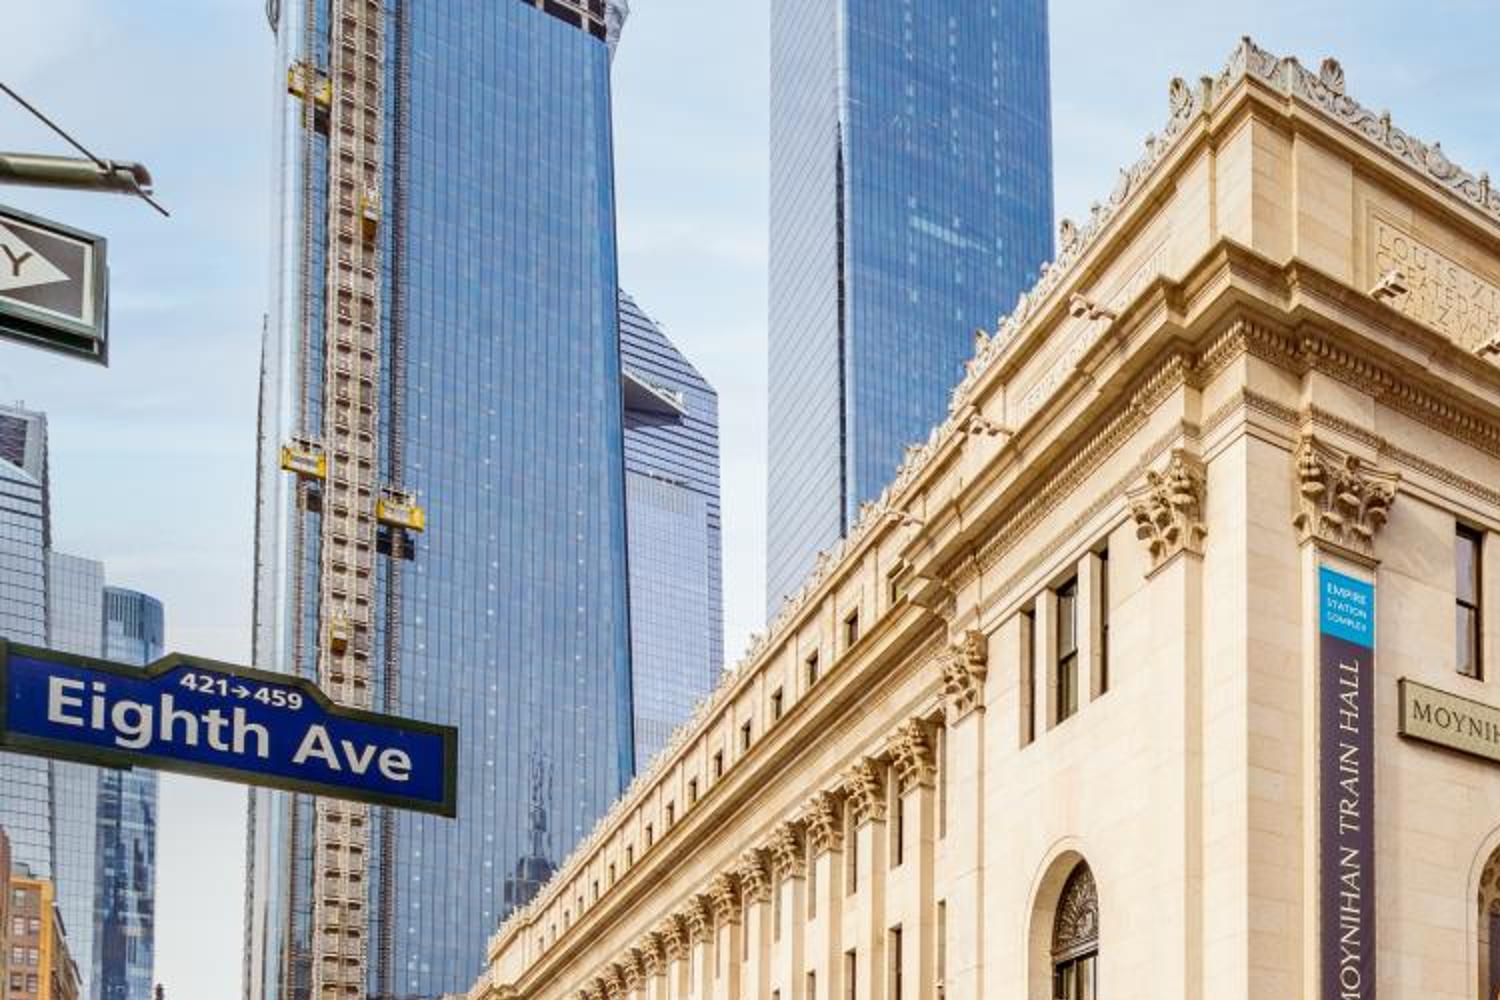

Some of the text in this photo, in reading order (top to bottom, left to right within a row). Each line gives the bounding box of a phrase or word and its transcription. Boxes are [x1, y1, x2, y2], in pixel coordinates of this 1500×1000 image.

[1327, 597, 1367, 620] STATION
[47, 675, 412, 781] Eighth Ave
[180, 671, 303, 711] 421 459
[1339, 658, 1360, 734] HALL
[1339, 743, 1361, 836] TRAIN
